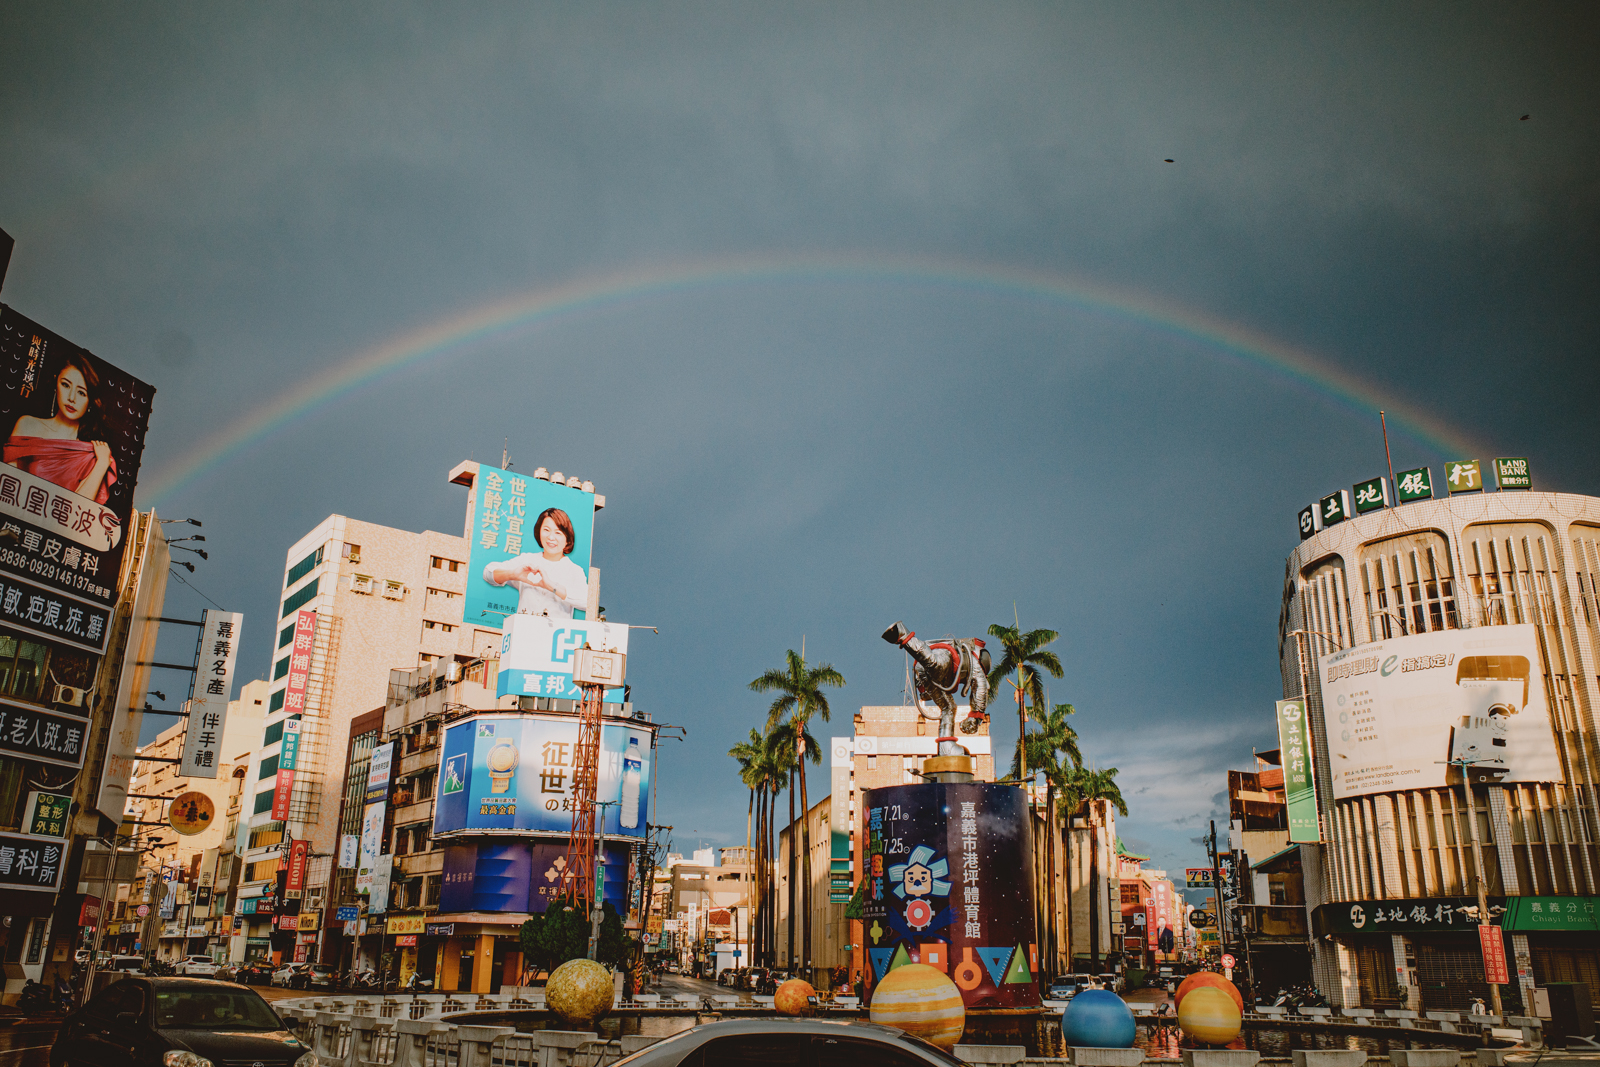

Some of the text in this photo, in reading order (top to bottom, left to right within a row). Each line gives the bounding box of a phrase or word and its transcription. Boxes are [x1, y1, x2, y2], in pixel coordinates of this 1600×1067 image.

[20, 334, 42, 398] 與時光逆行
[1499, 460, 1527, 468] LAND
[1501, 467, 1528, 476] BANK
[0, 473, 96, 537] 鳳凰電波
[1325, 464, 1478, 519] 土地銀行
[480, 472, 504, 550] 全齡共享
[504, 477, 527, 556] 世代宜居
[487, 602, 516, 613] 嘉義市市長
[285, 615, 313, 709] 弘群補習班
[1327, 656, 1380, 684] 即時理財
[194, 621, 235, 768] 嘉義名產 伴手禮
[523, 673, 609, 700] 富邦人
[283, 734, 295, 768] 聯邦銀行
[1288, 724, 1304, 773] 土地銀行
[39, 804, 63, 820] 整形
[480, 804, 517, 815] 最高金賞
[884, 804, 901, 821] 7.21
[35, 820, 61, 836] 外科
[884, 837, 904, 854] 7.25
[38, 845, 59, 884] 診所
[290, 843, 305, 886] Canon
[960, 802, 981, 939] 嘉義市港坪體育館
[1373, 903, 1454, 925] 土地銀行
[1531, 902, 1595, 913] 嘉義分行
[1532, 914, 1598, 924] Chiayi Branch
[281, 917, 298, 928] 照相
